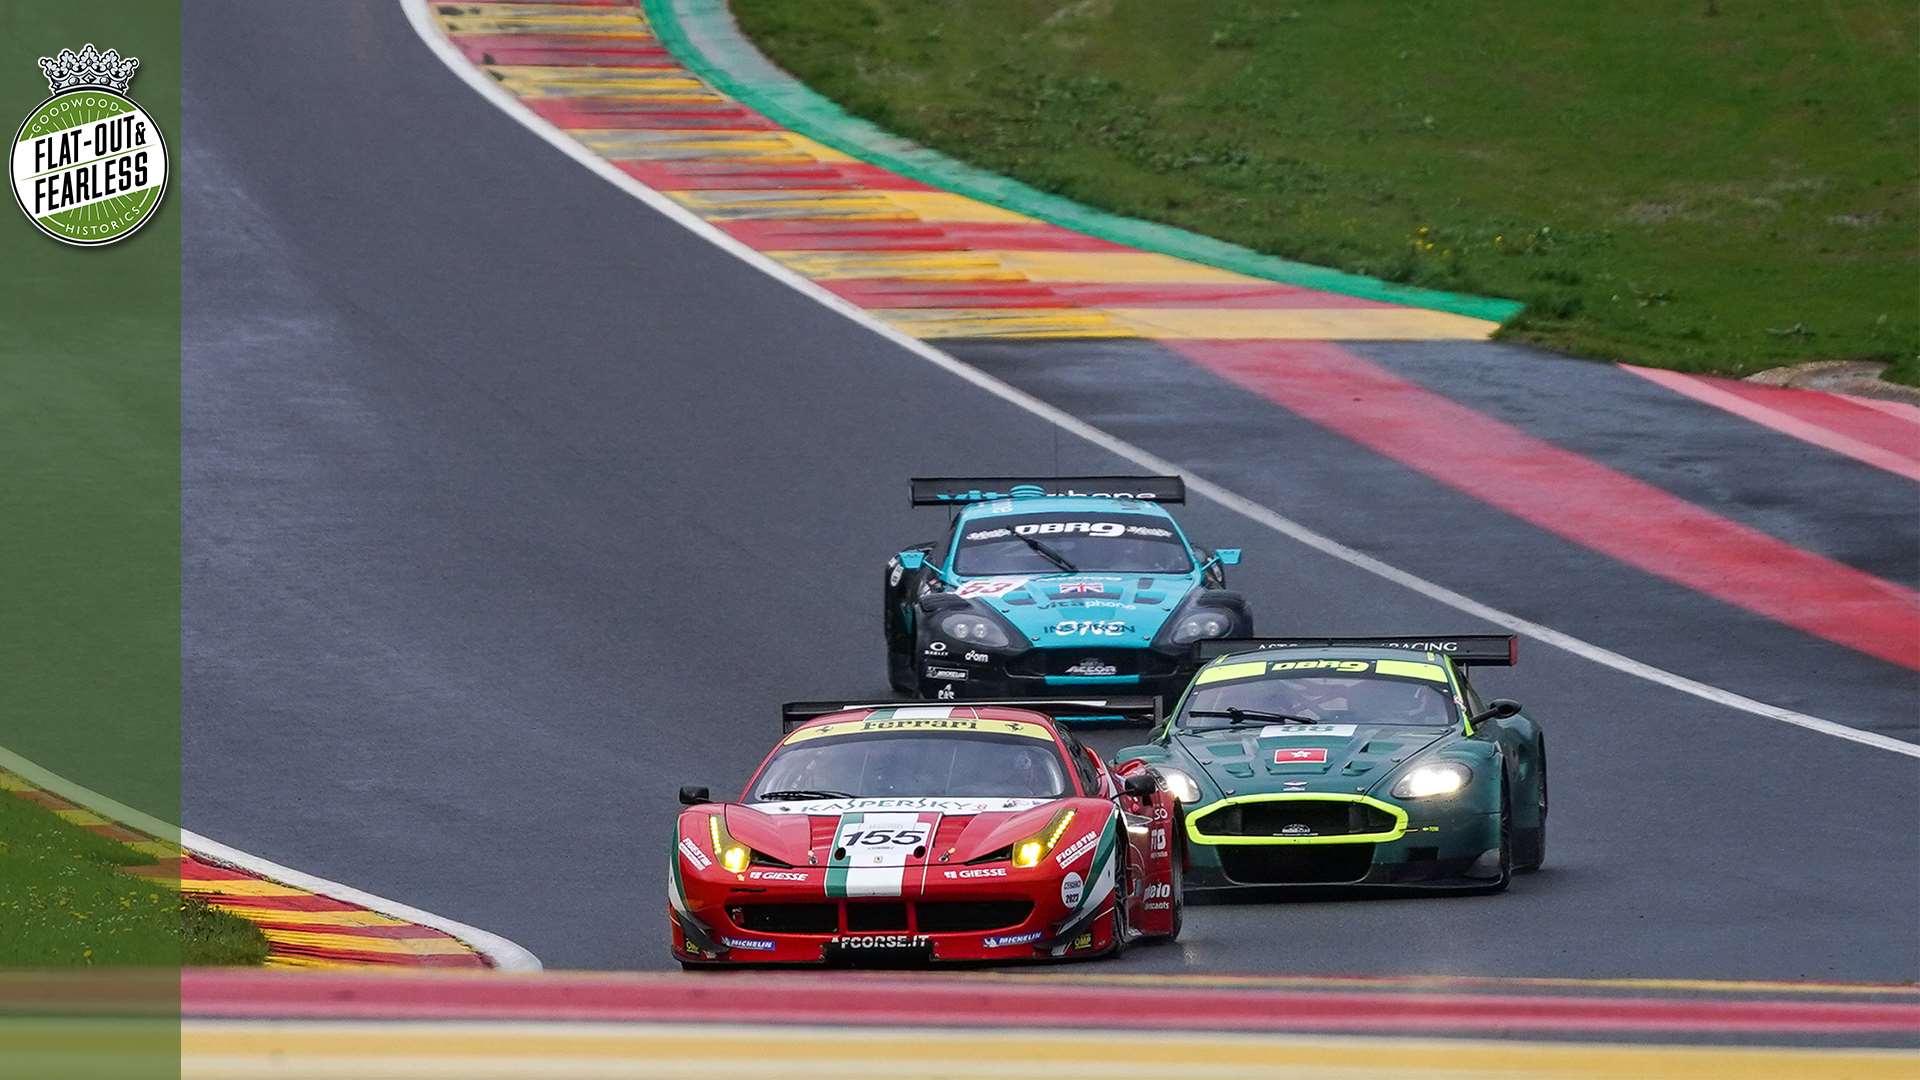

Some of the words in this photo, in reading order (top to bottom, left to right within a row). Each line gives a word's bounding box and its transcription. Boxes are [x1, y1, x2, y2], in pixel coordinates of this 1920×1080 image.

[863, 718, 977, 730] Ferrari
[801, 798, 971, 813] KASPERSKY
[843, 829, 926, 847] 155
[763, 871, 809, 881] GIESSE
[958, 868, 1008, 879] GIESSE
[999, 931, 1042, 944] MICHELIN
[731, 940, 773, 949] MICHELIN
